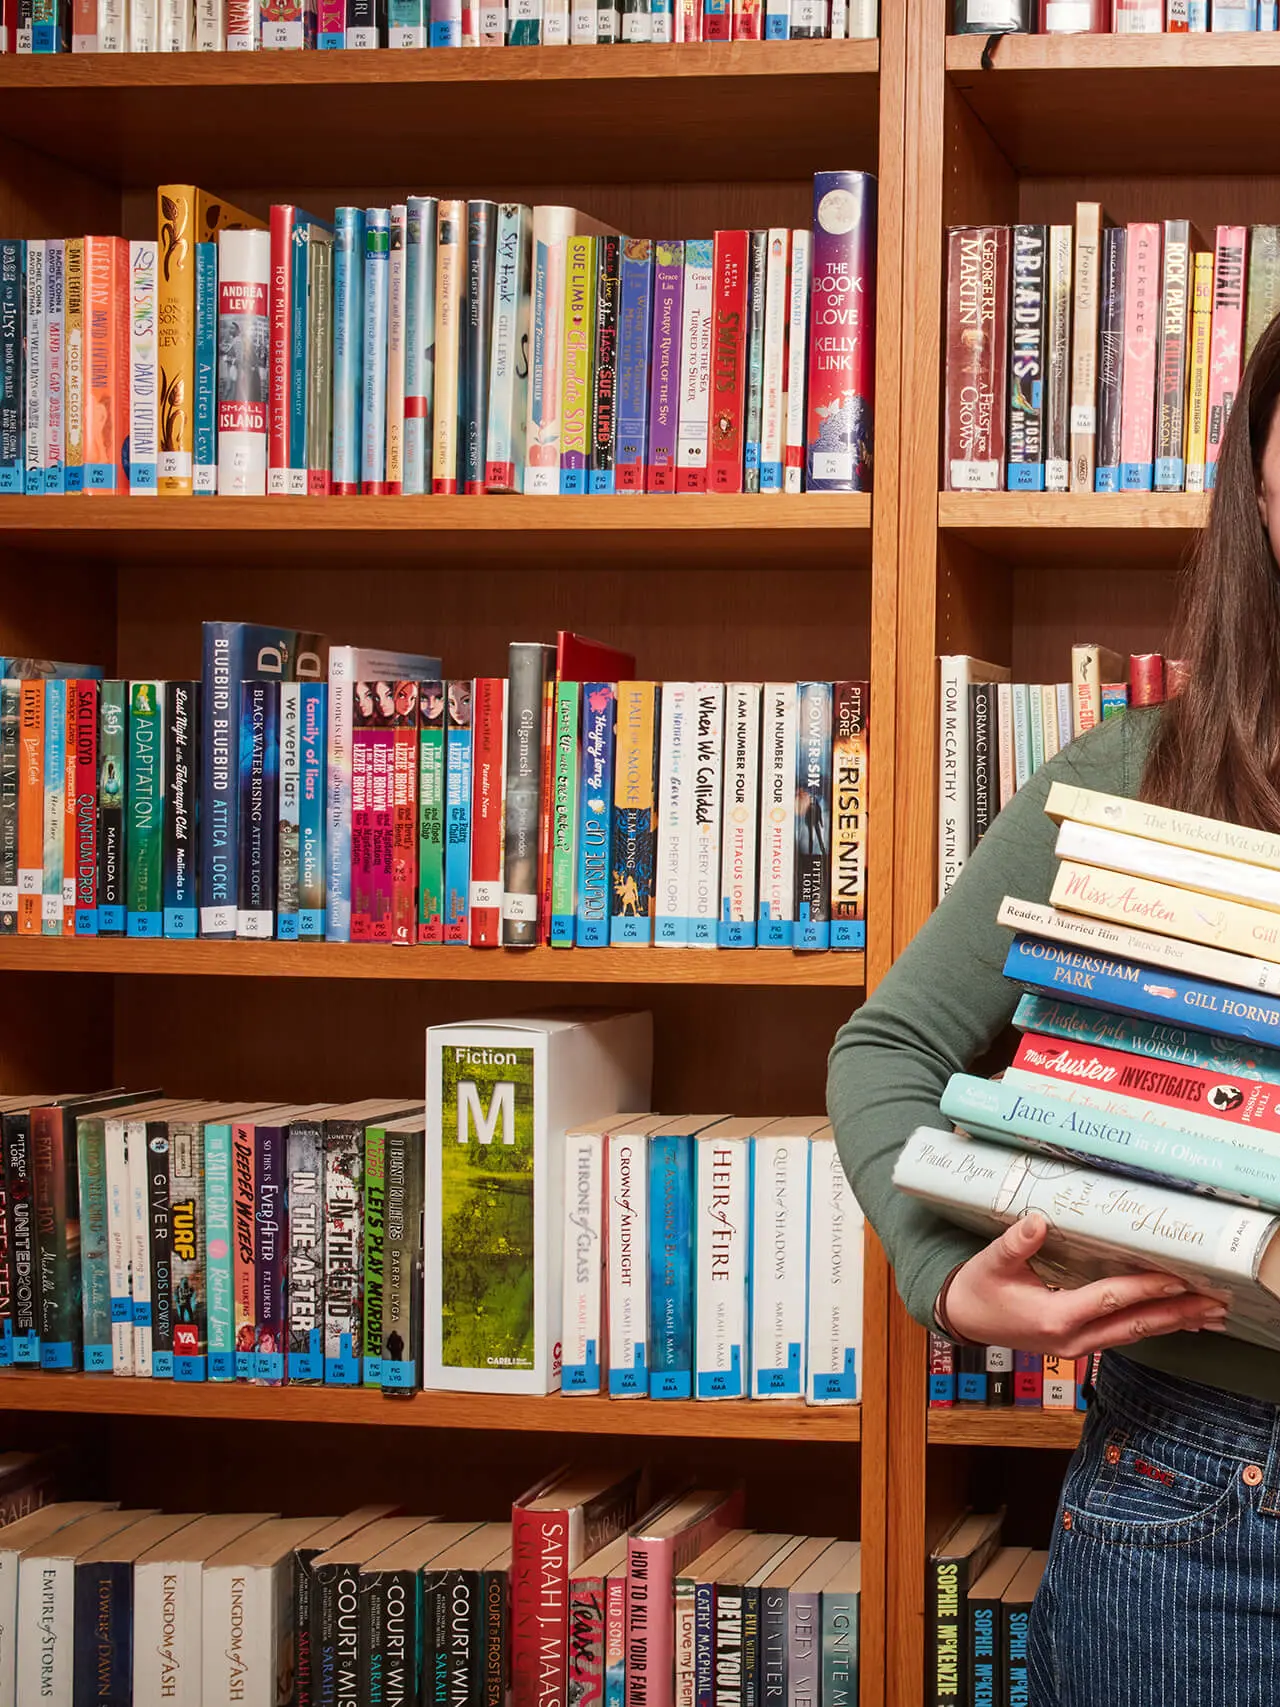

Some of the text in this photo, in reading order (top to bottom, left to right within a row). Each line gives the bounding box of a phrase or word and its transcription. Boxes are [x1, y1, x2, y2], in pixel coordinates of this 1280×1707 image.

[223, 286, 262, 298] ANDREA
[572, 246, 585, 311] SUE LIMB
[814, 277, 863, 292] BOOK
[826, 263, 848, 274] THE
[1165, 242, 1185, 334] ROCK PAPER
[230, 299, 255, 310] LEVY
[815, 309, 858, 325] LOVE
[828, 295, 845, 305] OF
[1014, 236, 1041, 377] ARIADNIS
[274, 266, 285, 438] HOT MILK DEBORAH LEVY
[717, 310, 740, 393] SWIFTS
[815, 337, 858, 351] KELLY
[817, 356, 852, 370] LINK
[220, 414, 263, 428] ISLAND
[221, 404, 262, 413] SMALL
[79, 691, 93, 765] SACI LLOYD
[305, 698, 323, 800] family of liars
[517, 710, 533, 777] Gilgamesh
[944, 678, 958, 802] TOM McCARTHY
[135, 718, 154, 828] ADAPTATION
[212, 639, 229, 900] BLUEBIRD, BLUEBIRD ATTICA LOCKE
[694, 695, 717, 825] When We Collided
[735, 722, 746, 803] NUMBER FOUR
[1144, 813, 1167, 830] The
[1170, 817, 1221, 843] Wicked
[1224, 829, 1250, 850] Wit
[1252, 836, 1266, 854] of
[1007, 904, 1120, 943] Reader, Married Him
[1064, 870, 1178, 924] Miss Austen
[1020, 940, 1140, 983] GODMERSHAM
[1253, 925, 1277, 947] Gill
[1053, 966, 1095, 991] PARK
[1184, 990, 1219, 1013] GILL
[455, 1049, 517, 1066] Fiction
[1132, 1037, 1200, 1063] WORSLEY
[1152, 1026, 1187, 1045] LUCY
[1045, 1050, 1117, 1083] Austen
[1119, 1066, 1206, 1102] INVESTIGATES
[1242, 1086, 1263, 1122] JESSICA
[1254, 1092, 1270, 1118] BULL
[457, 1081, 515, 1146] M
[1002, 1095, 1055, 1129] Jane
[1058, 1110, 1133, 1146] Austen
[1170, 1139, 1225, 1171] Objects
[917, 1144, 997, 1182] Paula Byrne
[153, 1174, 168, 1240] GIVER
[172, 1200, 196, 1261] TURF
[618, 1147, 632, 1287] CROWN MIDNIGHT
[708, 1150, 736, 1281] HEIR of FIRE
[1101, 1187, 1148, 1219] Jane
[1131, 1206, 1206, 1246] Austen
[1230, 1219, 1250, 1253] 920 AUS
[156, 1261, 170, 1338] LOIS LOWRY
[391, 1251, 400, 1322] BARRY LYGA
[540, 1523, 563, 1607] SARAH
[41, 1570, 56, 1697] EMPIRE STORMS
[161, 1575, 177, 1698] KINGDOM ASH
[337, 1578, 357, 1660] COURT
[717, 1597, 742, 1647] DEVIL
[767, 1596, 782, 1697] SHATTER
[937, 1563, 958, 1696] SOPHIE McKENZIE
